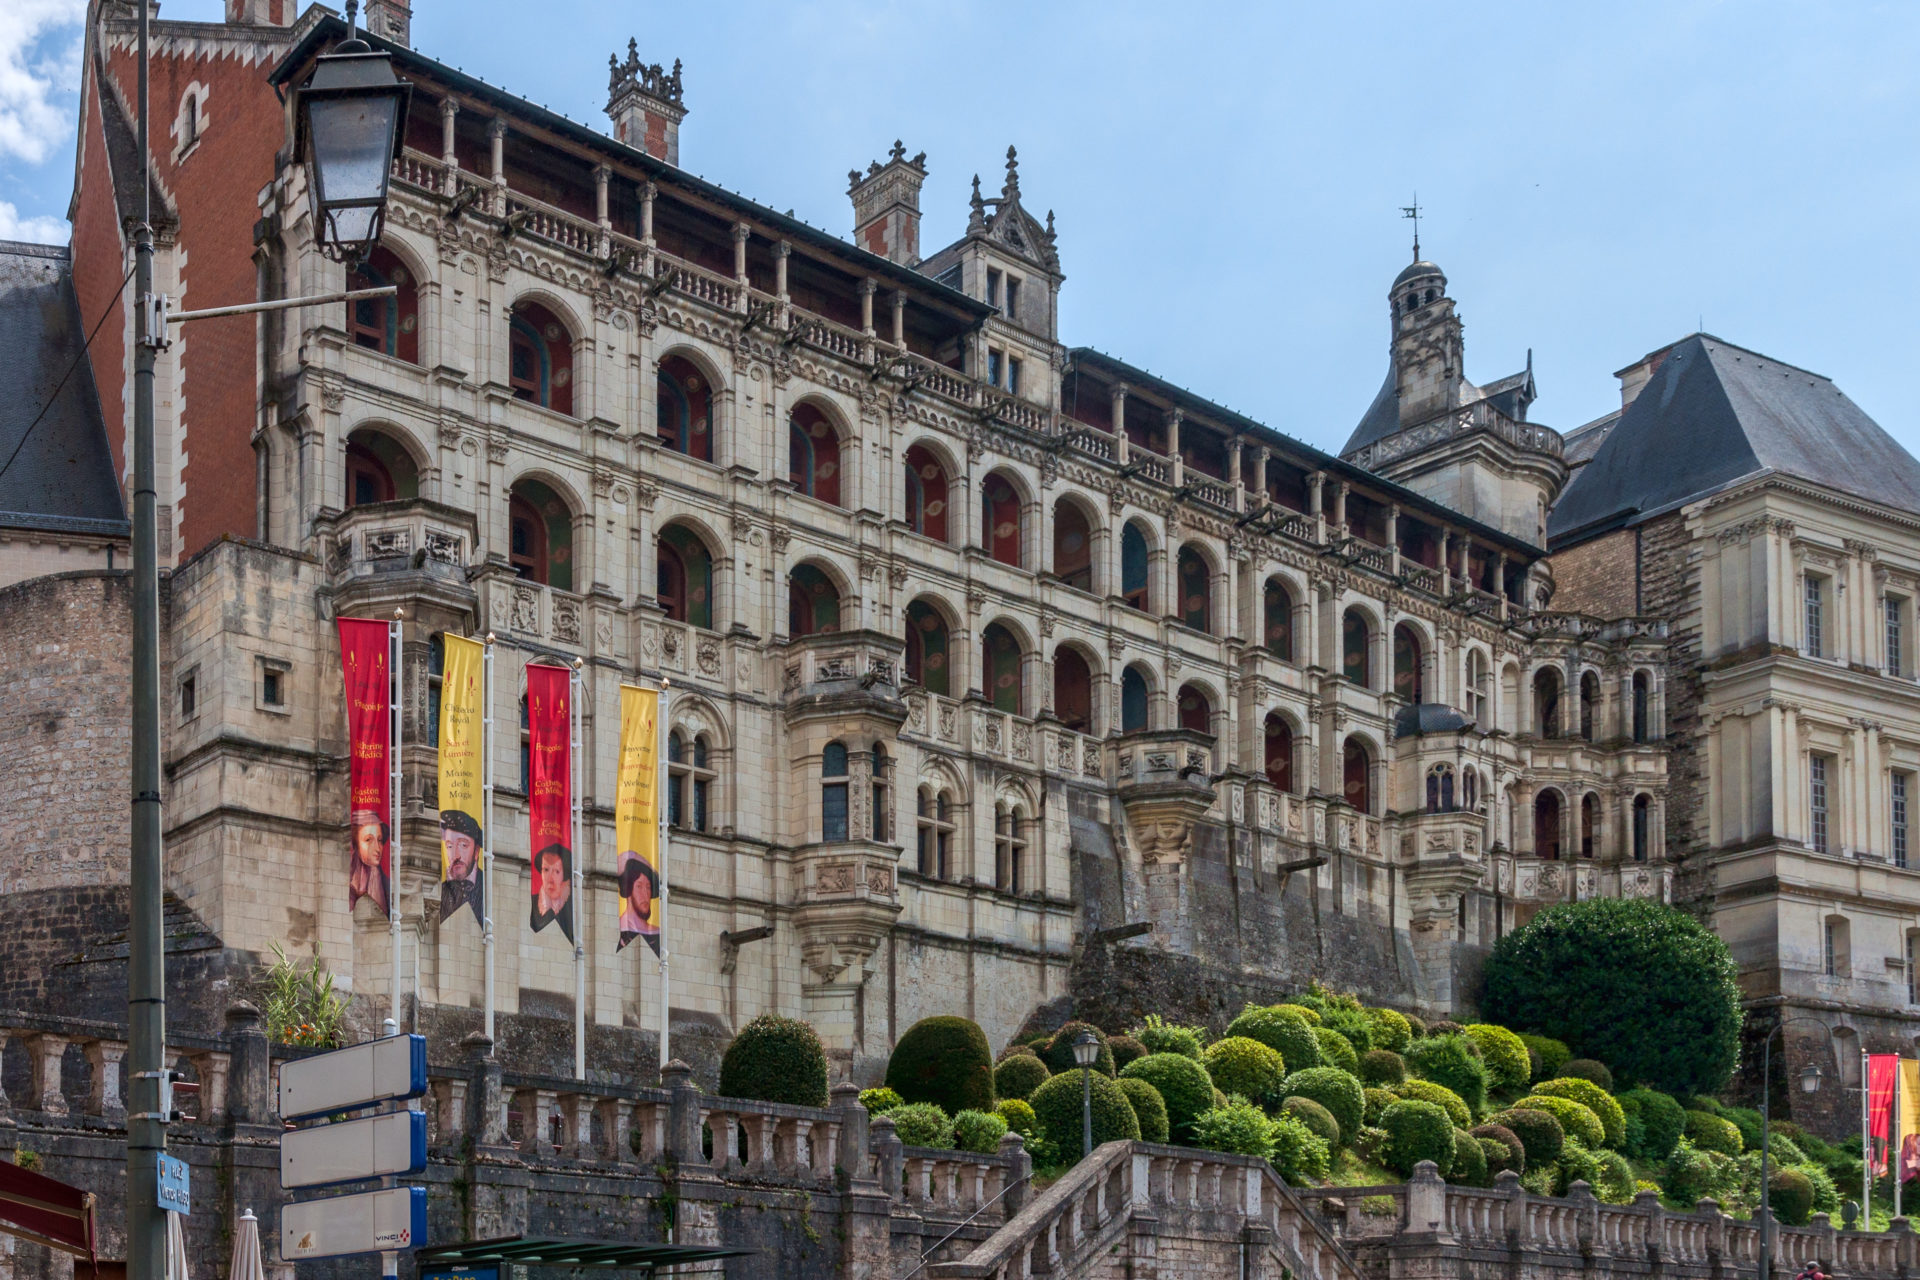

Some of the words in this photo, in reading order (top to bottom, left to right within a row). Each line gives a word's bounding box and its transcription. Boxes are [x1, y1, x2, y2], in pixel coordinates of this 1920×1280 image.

[446, 739, 459, 748] Son
[443, 749, 475, 759] Lumière
[451, 780, 462, 788] de
[535, 780, 563, 789] Cathe
[354, 787, 379, 796] Gaston
[534, 787, 544, 796] de
[160, 1183, 176, 1202] VICTOR
[176, 1189, 190, 1207] HUGO
